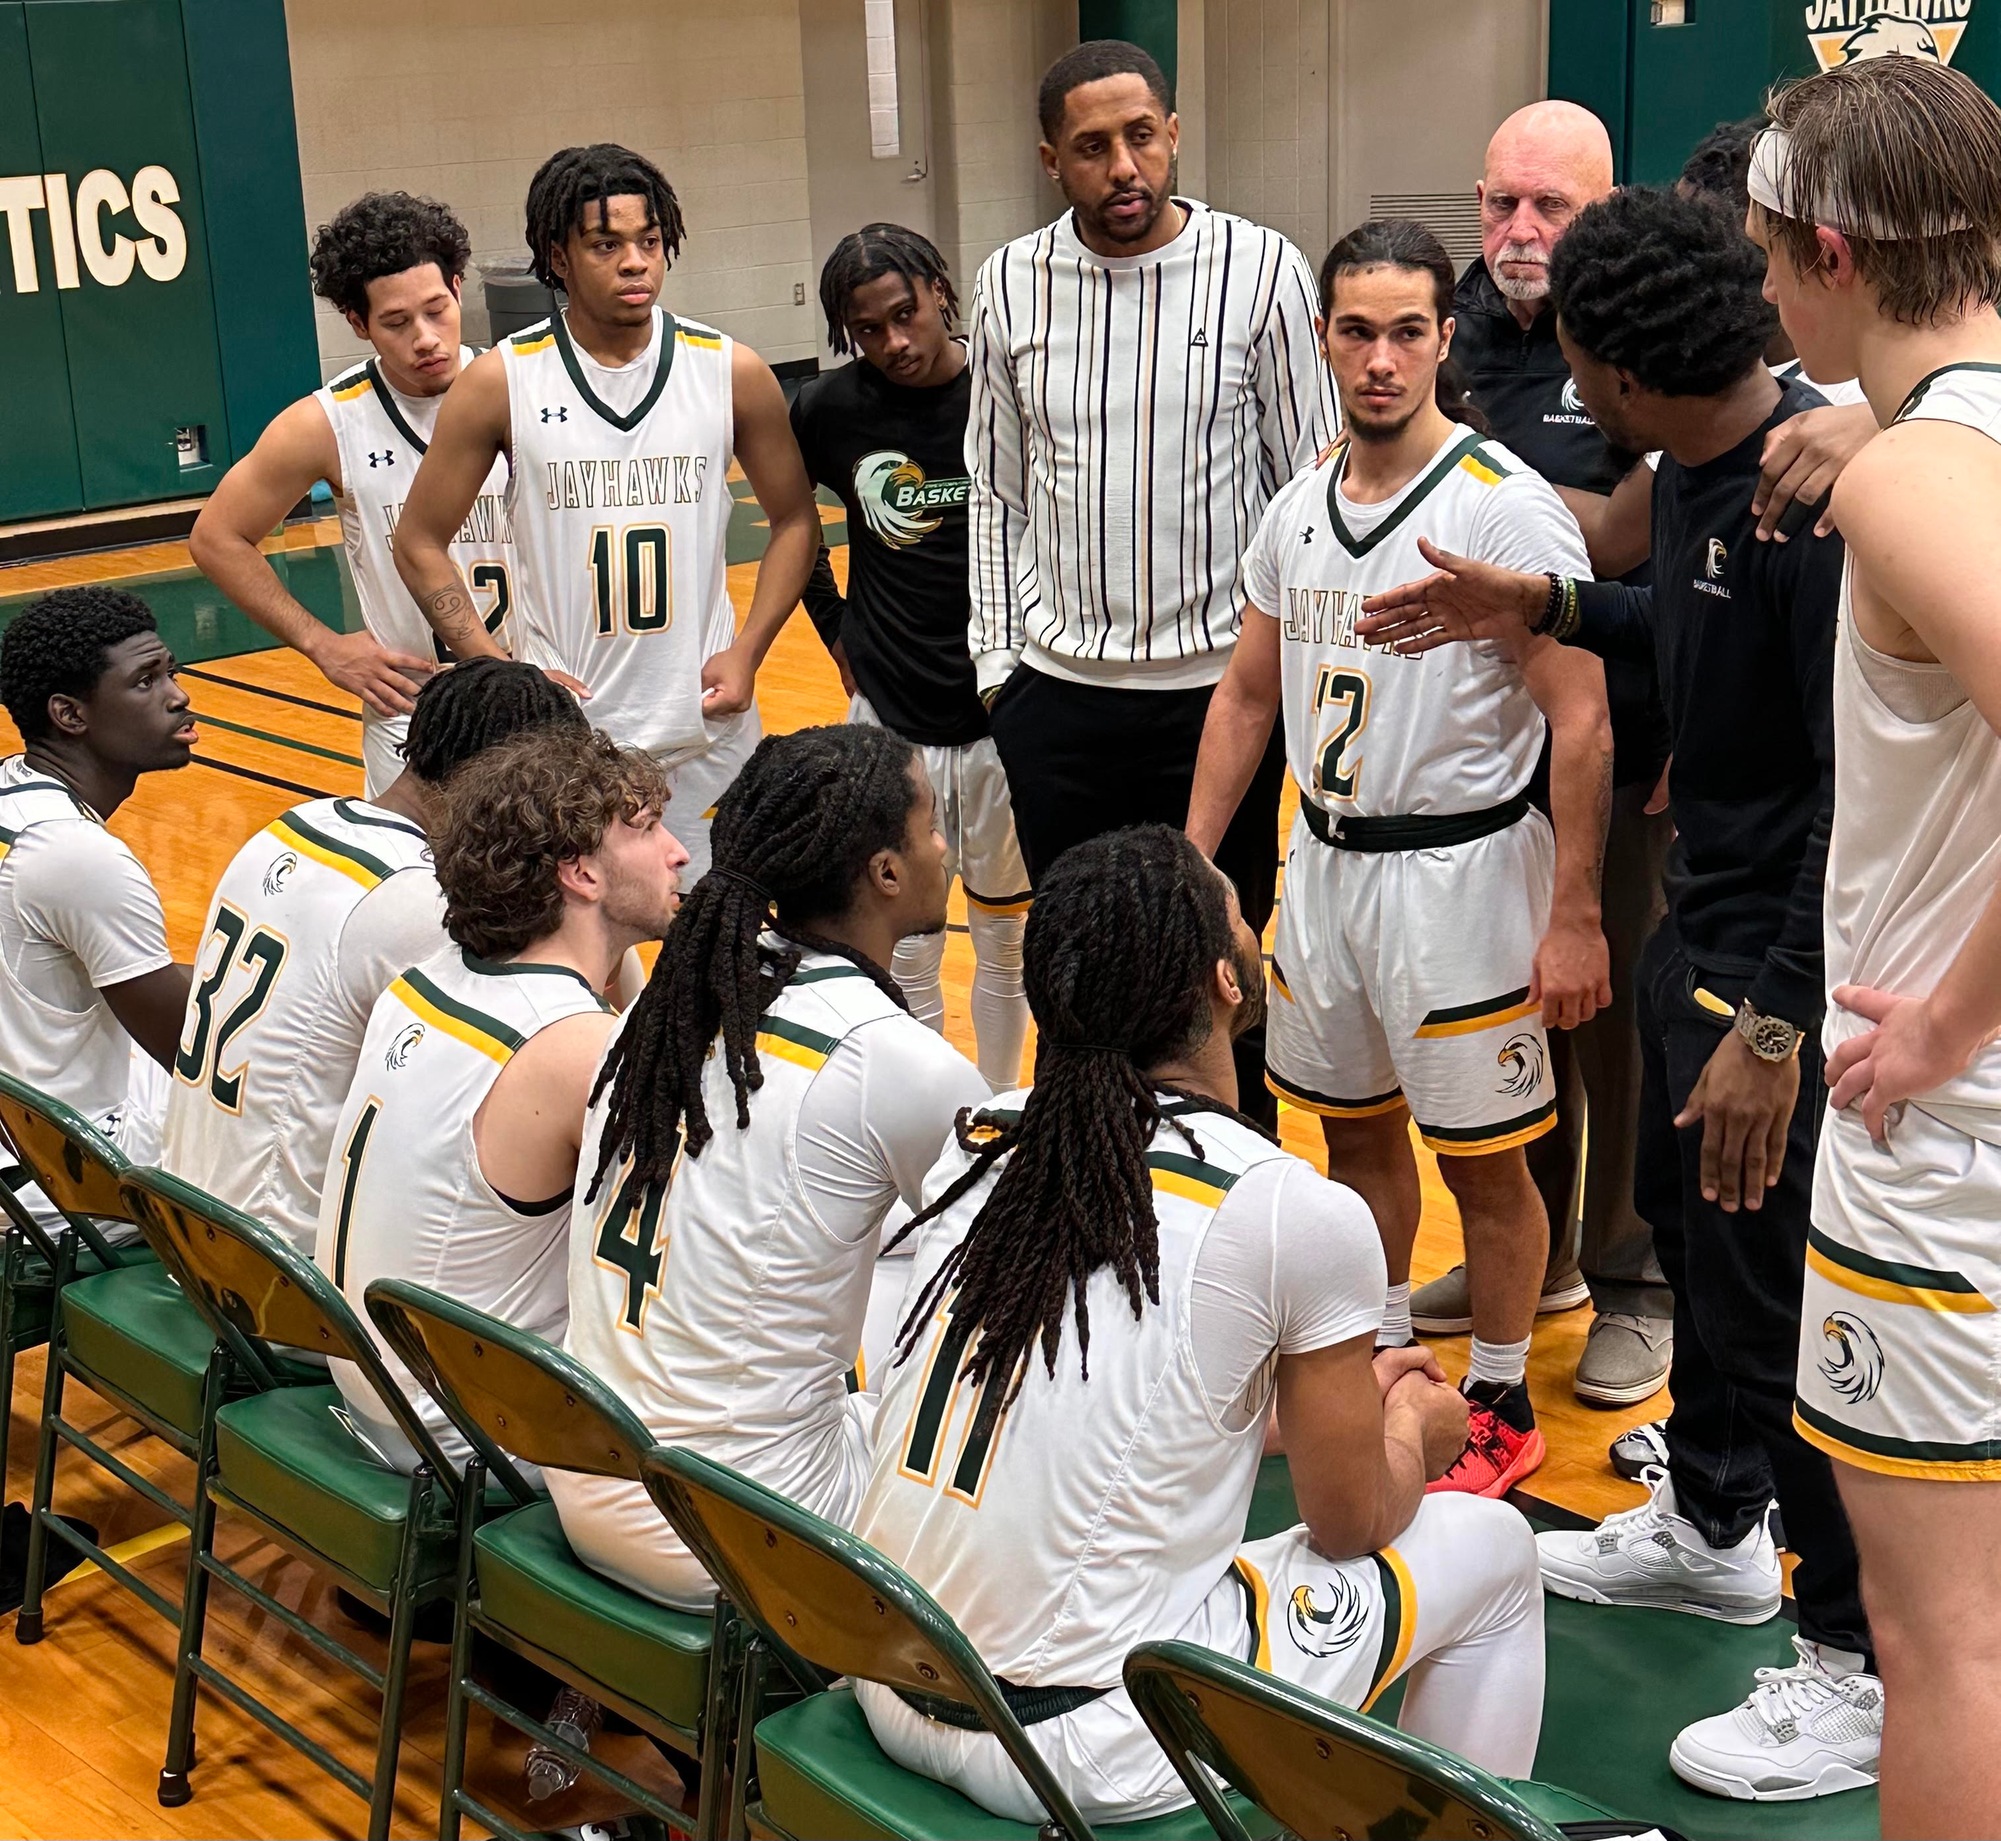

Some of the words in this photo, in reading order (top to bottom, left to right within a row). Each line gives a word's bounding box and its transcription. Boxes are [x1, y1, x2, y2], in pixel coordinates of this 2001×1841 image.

[1543, 414, 1596, 425] BASKETBAL
[547, 456, 707, 510] JAYHAWKS
[896, 486, 972, 507] BASKE
[587, 521, 673, 639] 10
[1284, 588, 1424, 660] JAYHA
[174, 897, 290, 1116] 32
[332, 1095, 383, 1298] 1
[591, 1121, 686, 1340] 4
[896, 1283, 1042, 1511] 11
